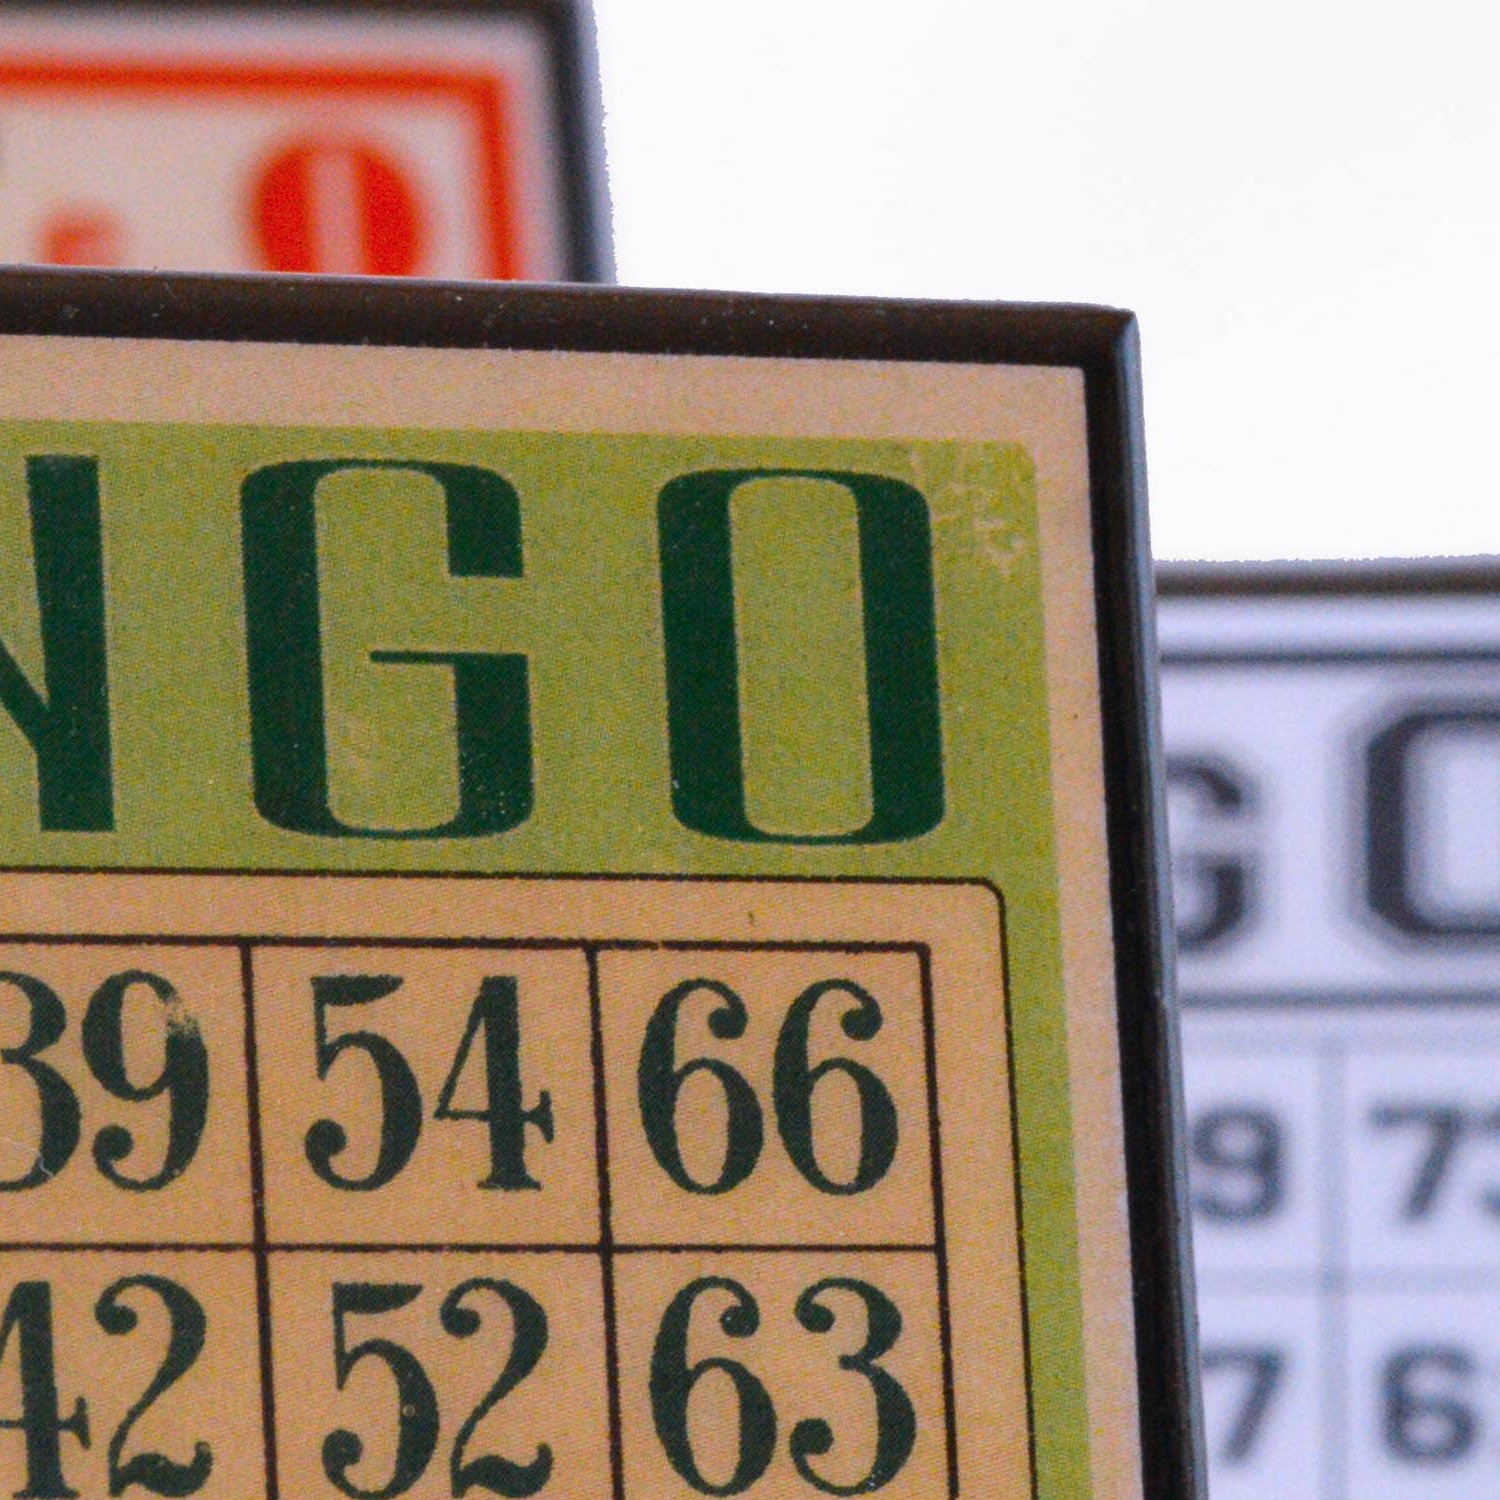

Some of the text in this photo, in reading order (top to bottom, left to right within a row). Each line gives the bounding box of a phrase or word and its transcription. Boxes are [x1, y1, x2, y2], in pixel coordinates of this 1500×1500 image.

[305, 974, 554, 1191] 54
[637, 977, 898, 1195] 66
[648, 1276, 916, 1498] 63
